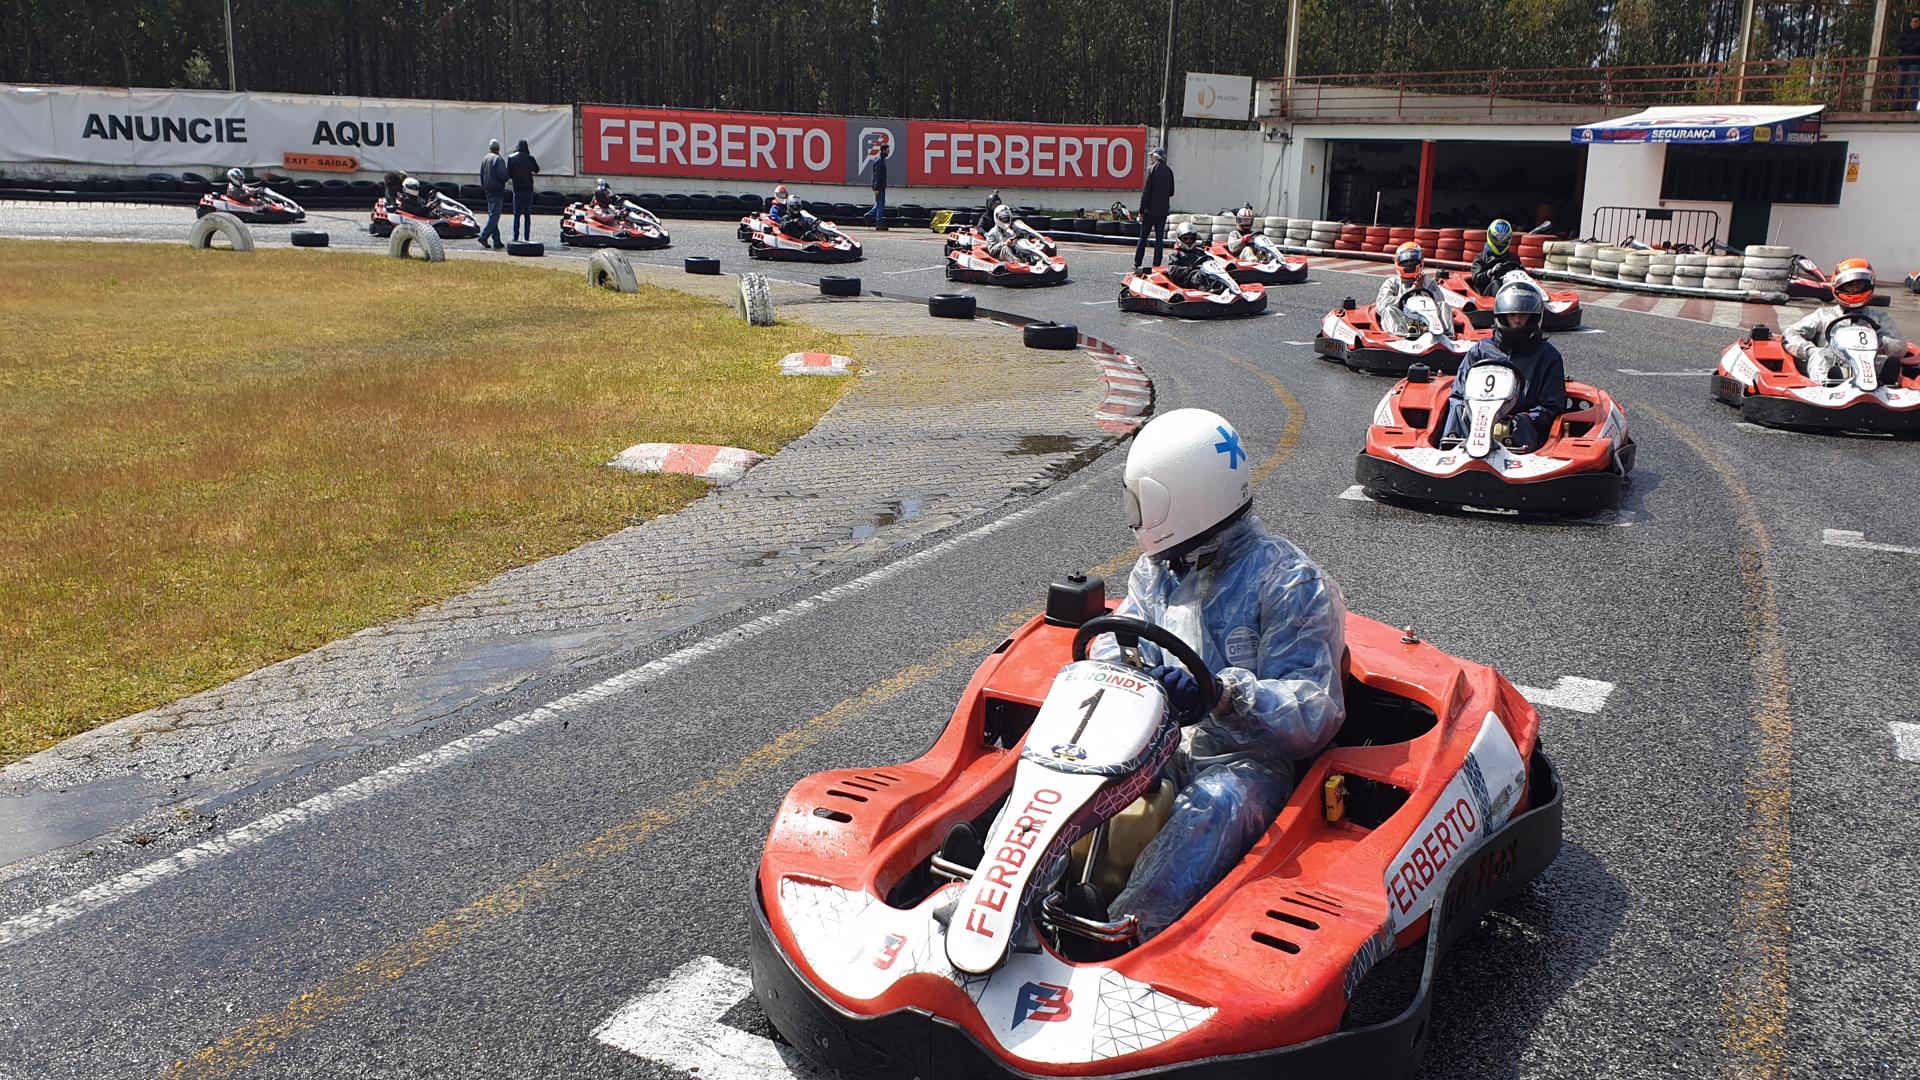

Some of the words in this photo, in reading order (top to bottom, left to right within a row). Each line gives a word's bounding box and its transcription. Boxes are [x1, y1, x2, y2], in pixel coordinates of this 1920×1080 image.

[82, 113, 248, 144] ANUNCIE
[312, 120, 396, 148] AQUI
[599, 118, 833, 172] FERBERTO
[1651, 128, 1717, 141] SEGURANÇA
[284, 156, 309, 165] EXIT
[923, 132, 1134, 179] FERBERTO
[1858, 331, 1869, 346] 8
[1484, 375, 1495, 393] 9
[1078, 687, 1106, 745] 1
[965, 788, 1063, 939] FERBERTO
